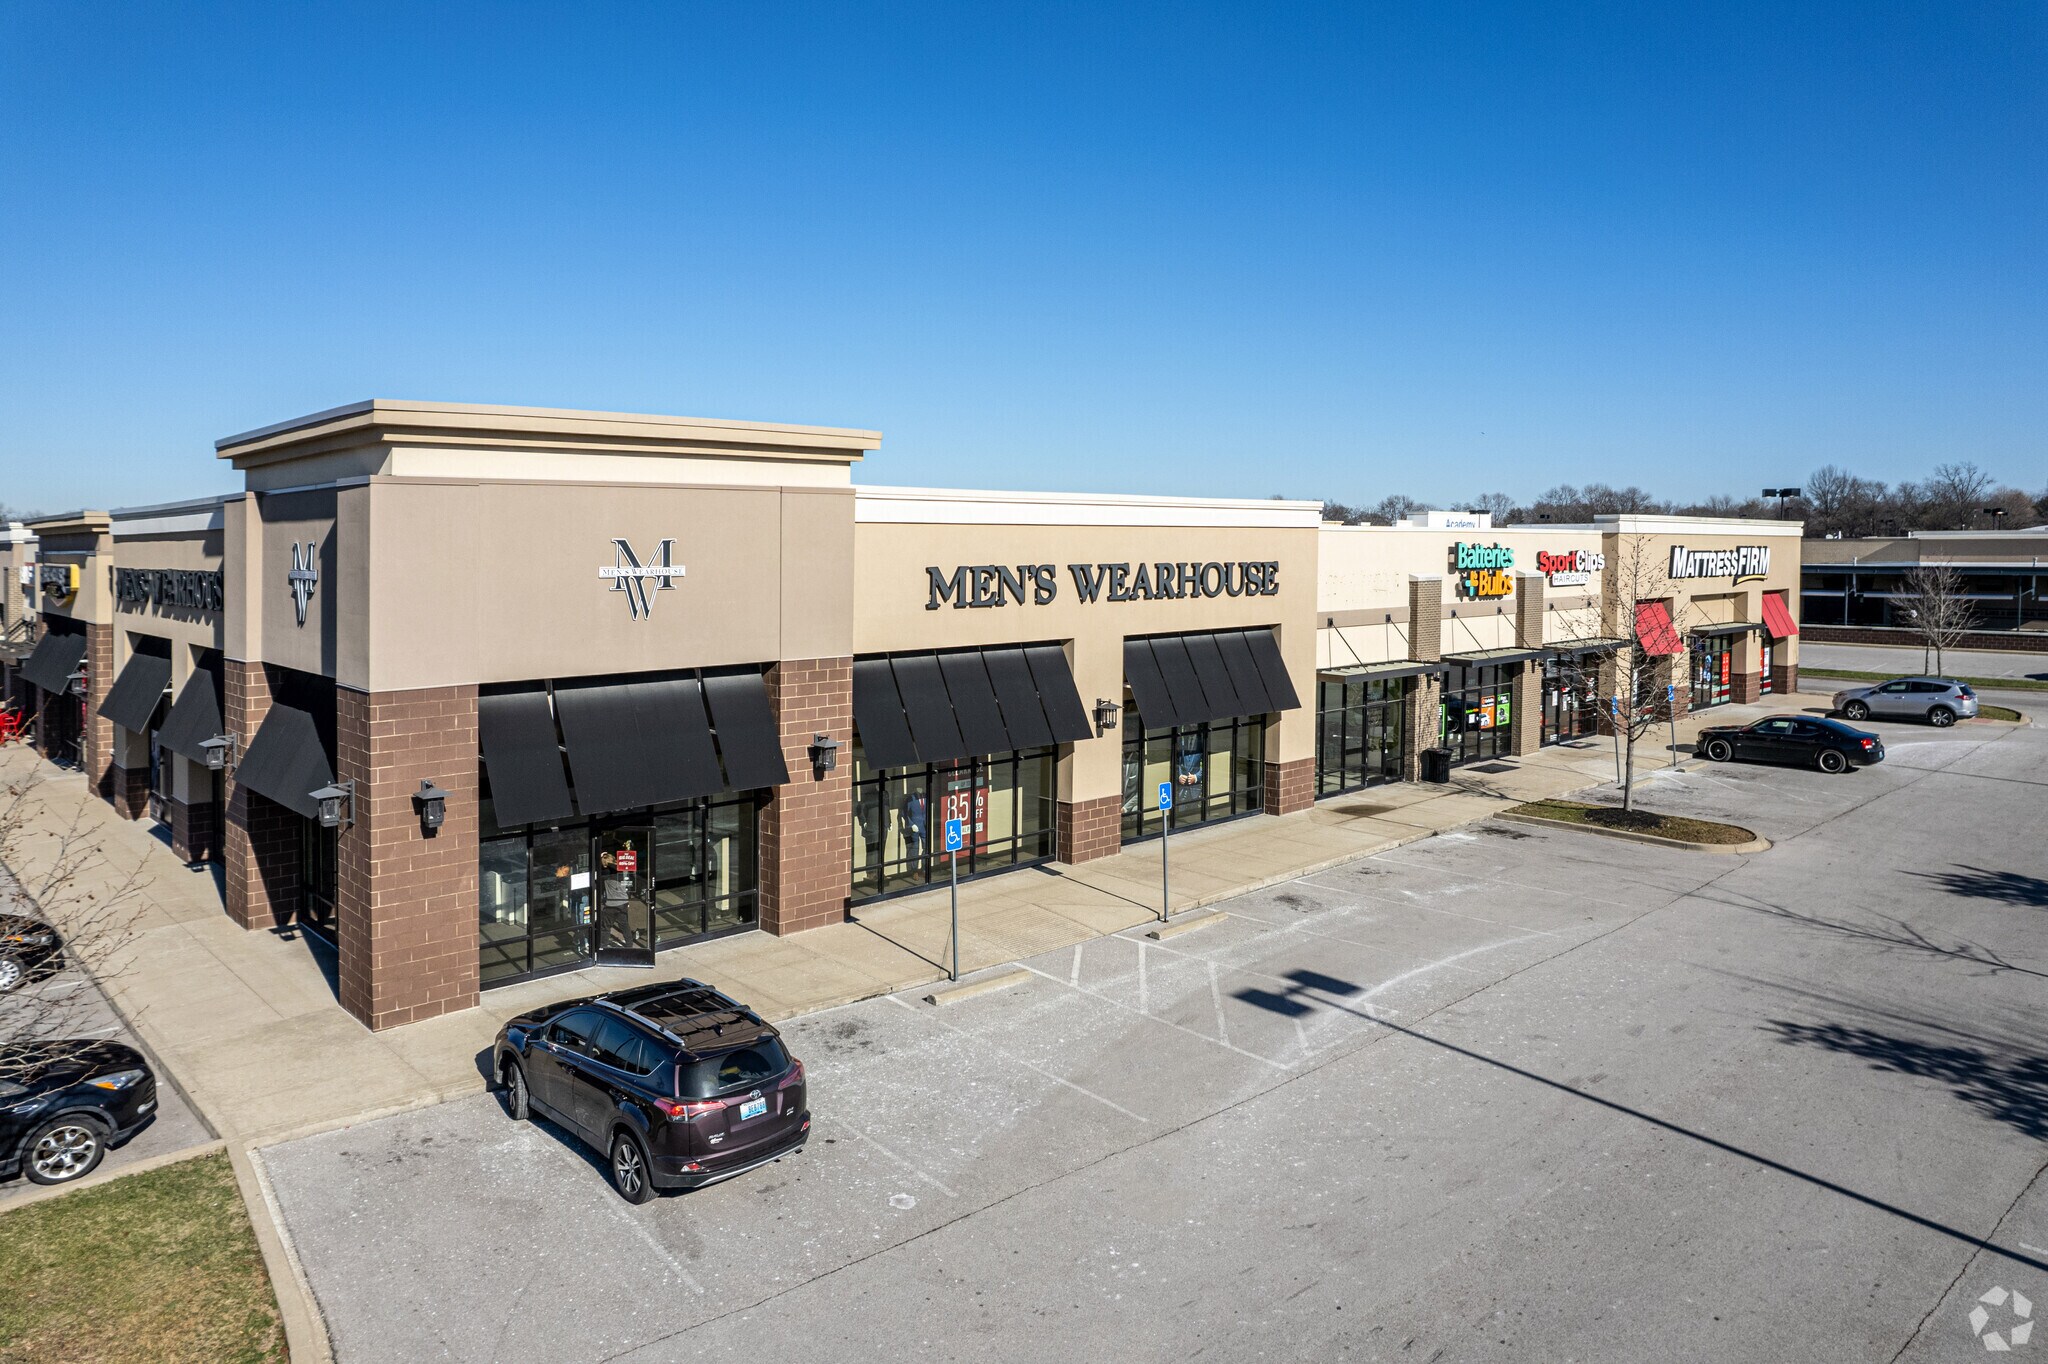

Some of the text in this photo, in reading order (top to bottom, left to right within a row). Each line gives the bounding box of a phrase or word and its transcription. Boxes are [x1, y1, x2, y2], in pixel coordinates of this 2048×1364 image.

[1456, 543, 1514, 569] Batteries
[631, 568, 682, 576] WEARHOUSE
[1553, 574, 1588, 584] HAIRCUTS
[149, 568, 224, 611] WEARHOUS
[925, 561, 1280, 610] MEN'S WEARHOUSE
